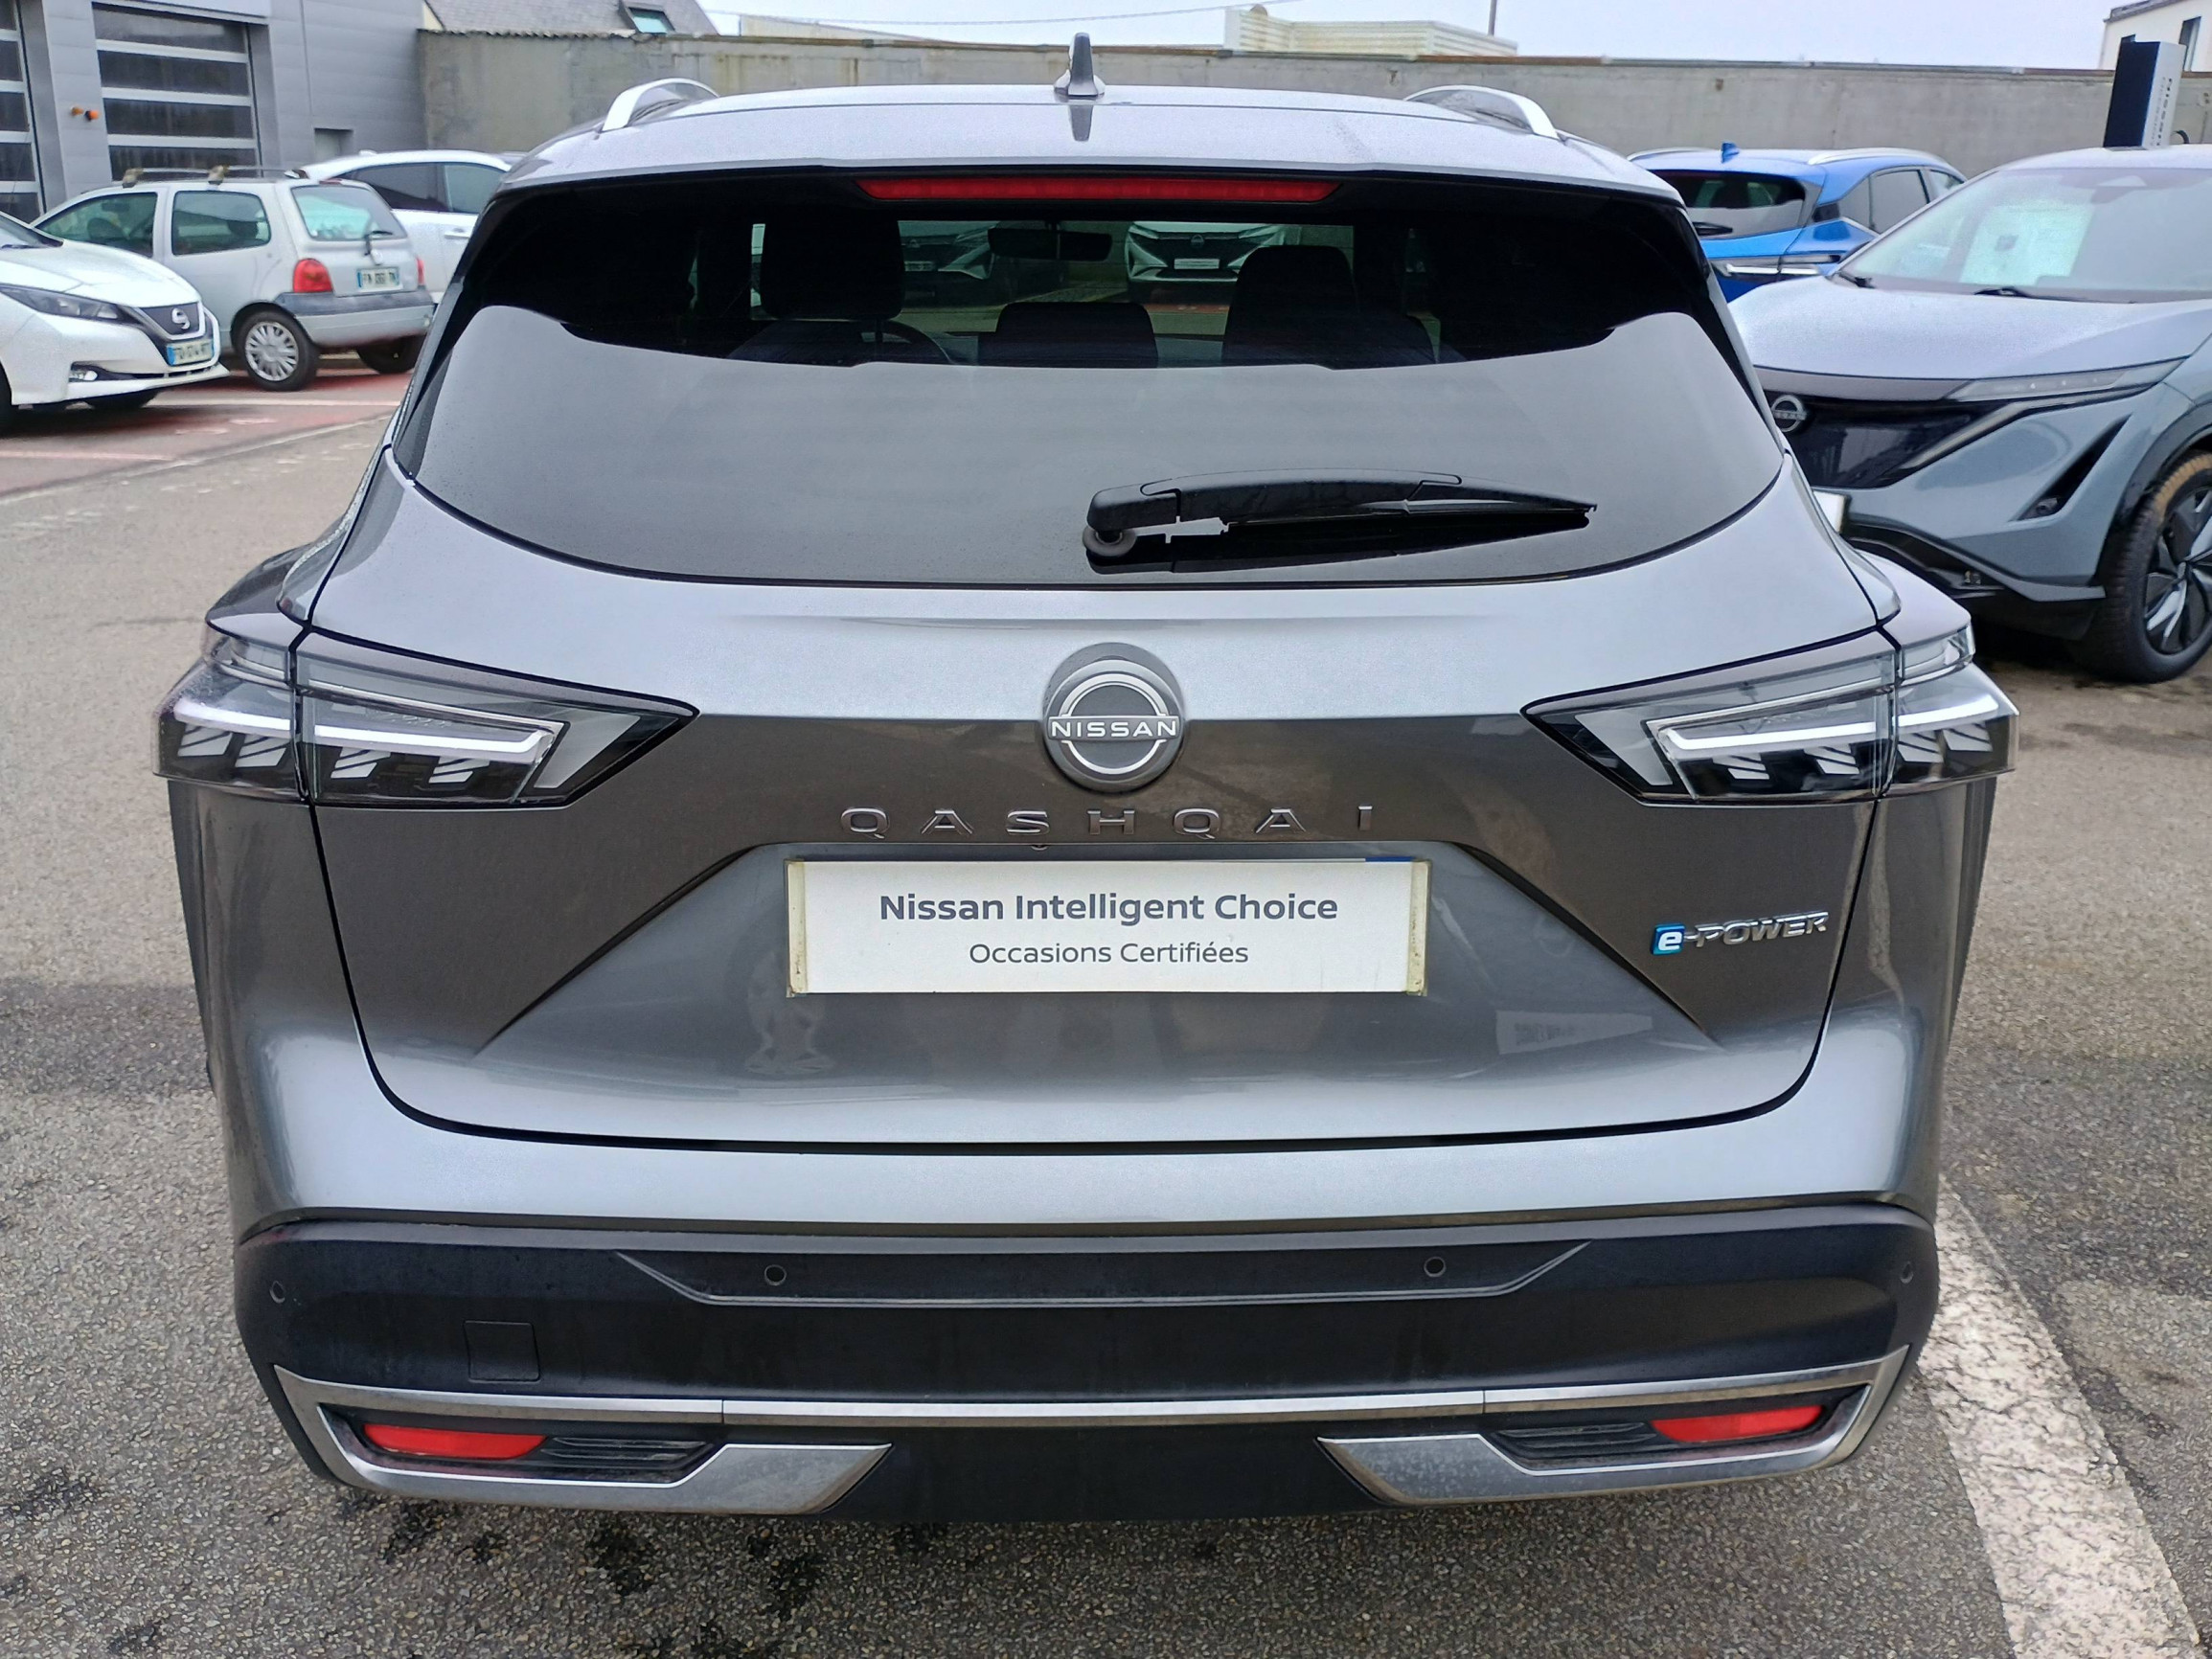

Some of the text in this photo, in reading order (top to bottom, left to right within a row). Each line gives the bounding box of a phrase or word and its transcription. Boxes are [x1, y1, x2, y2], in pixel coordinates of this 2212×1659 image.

[1051, 720, 1176, 738] NISSAN
[841, 806, 1373, 839] QASHQAI
[880, 894, 1338, 926] Nissan Intelligent Choice
[1656, 911, 1829, 952] e-POWER
[969, 942, 1248, 964] Occasions Certifiées
